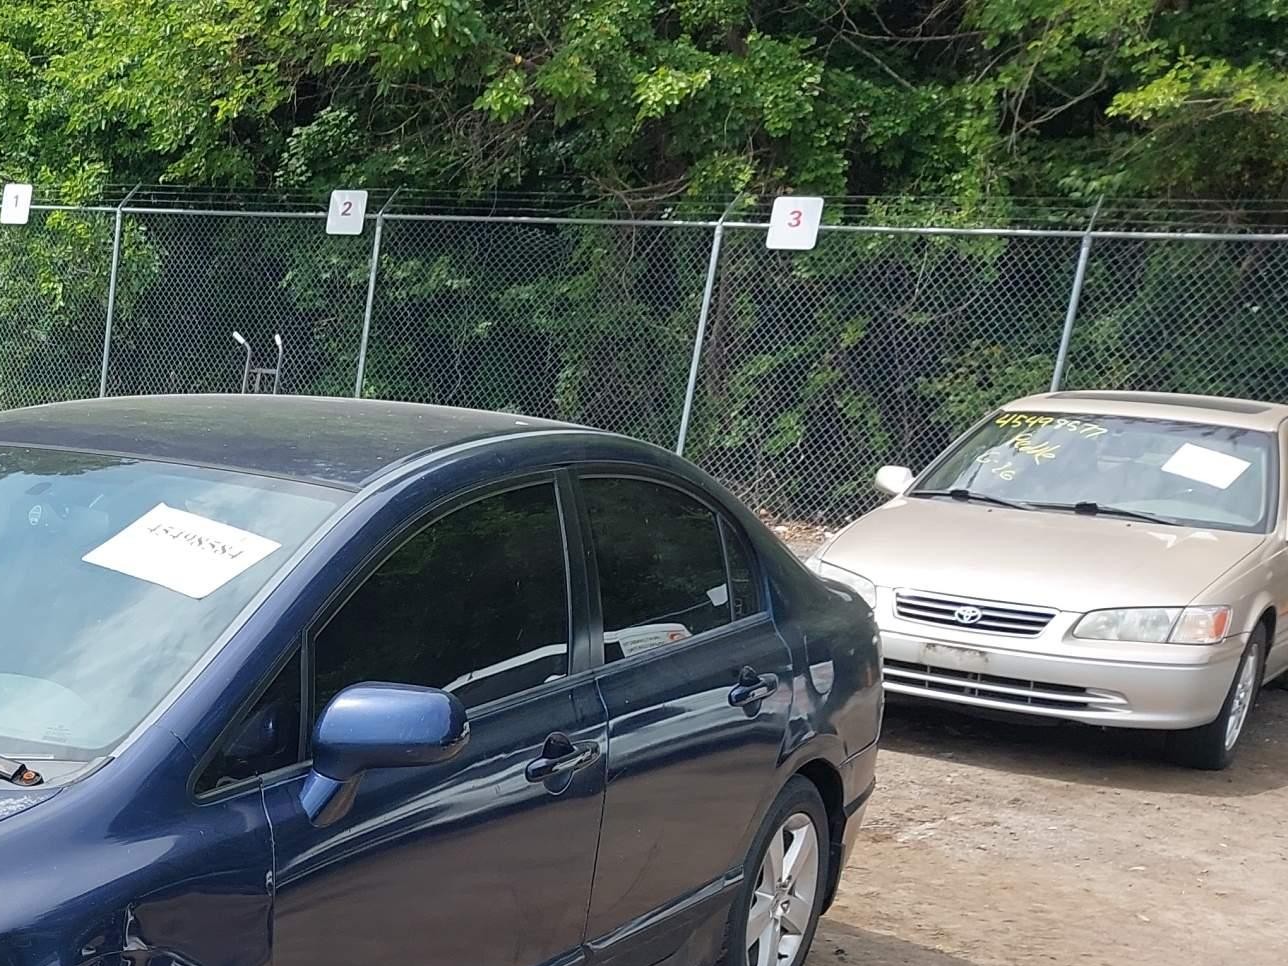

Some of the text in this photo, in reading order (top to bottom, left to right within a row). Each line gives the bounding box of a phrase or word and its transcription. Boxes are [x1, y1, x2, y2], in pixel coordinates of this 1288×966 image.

[13, 194, 20, 209] 1
[341, 201, 353, 217] 2
[787, 210, 802, 228] 3
[995, 413, 1109, 438] 45498577
